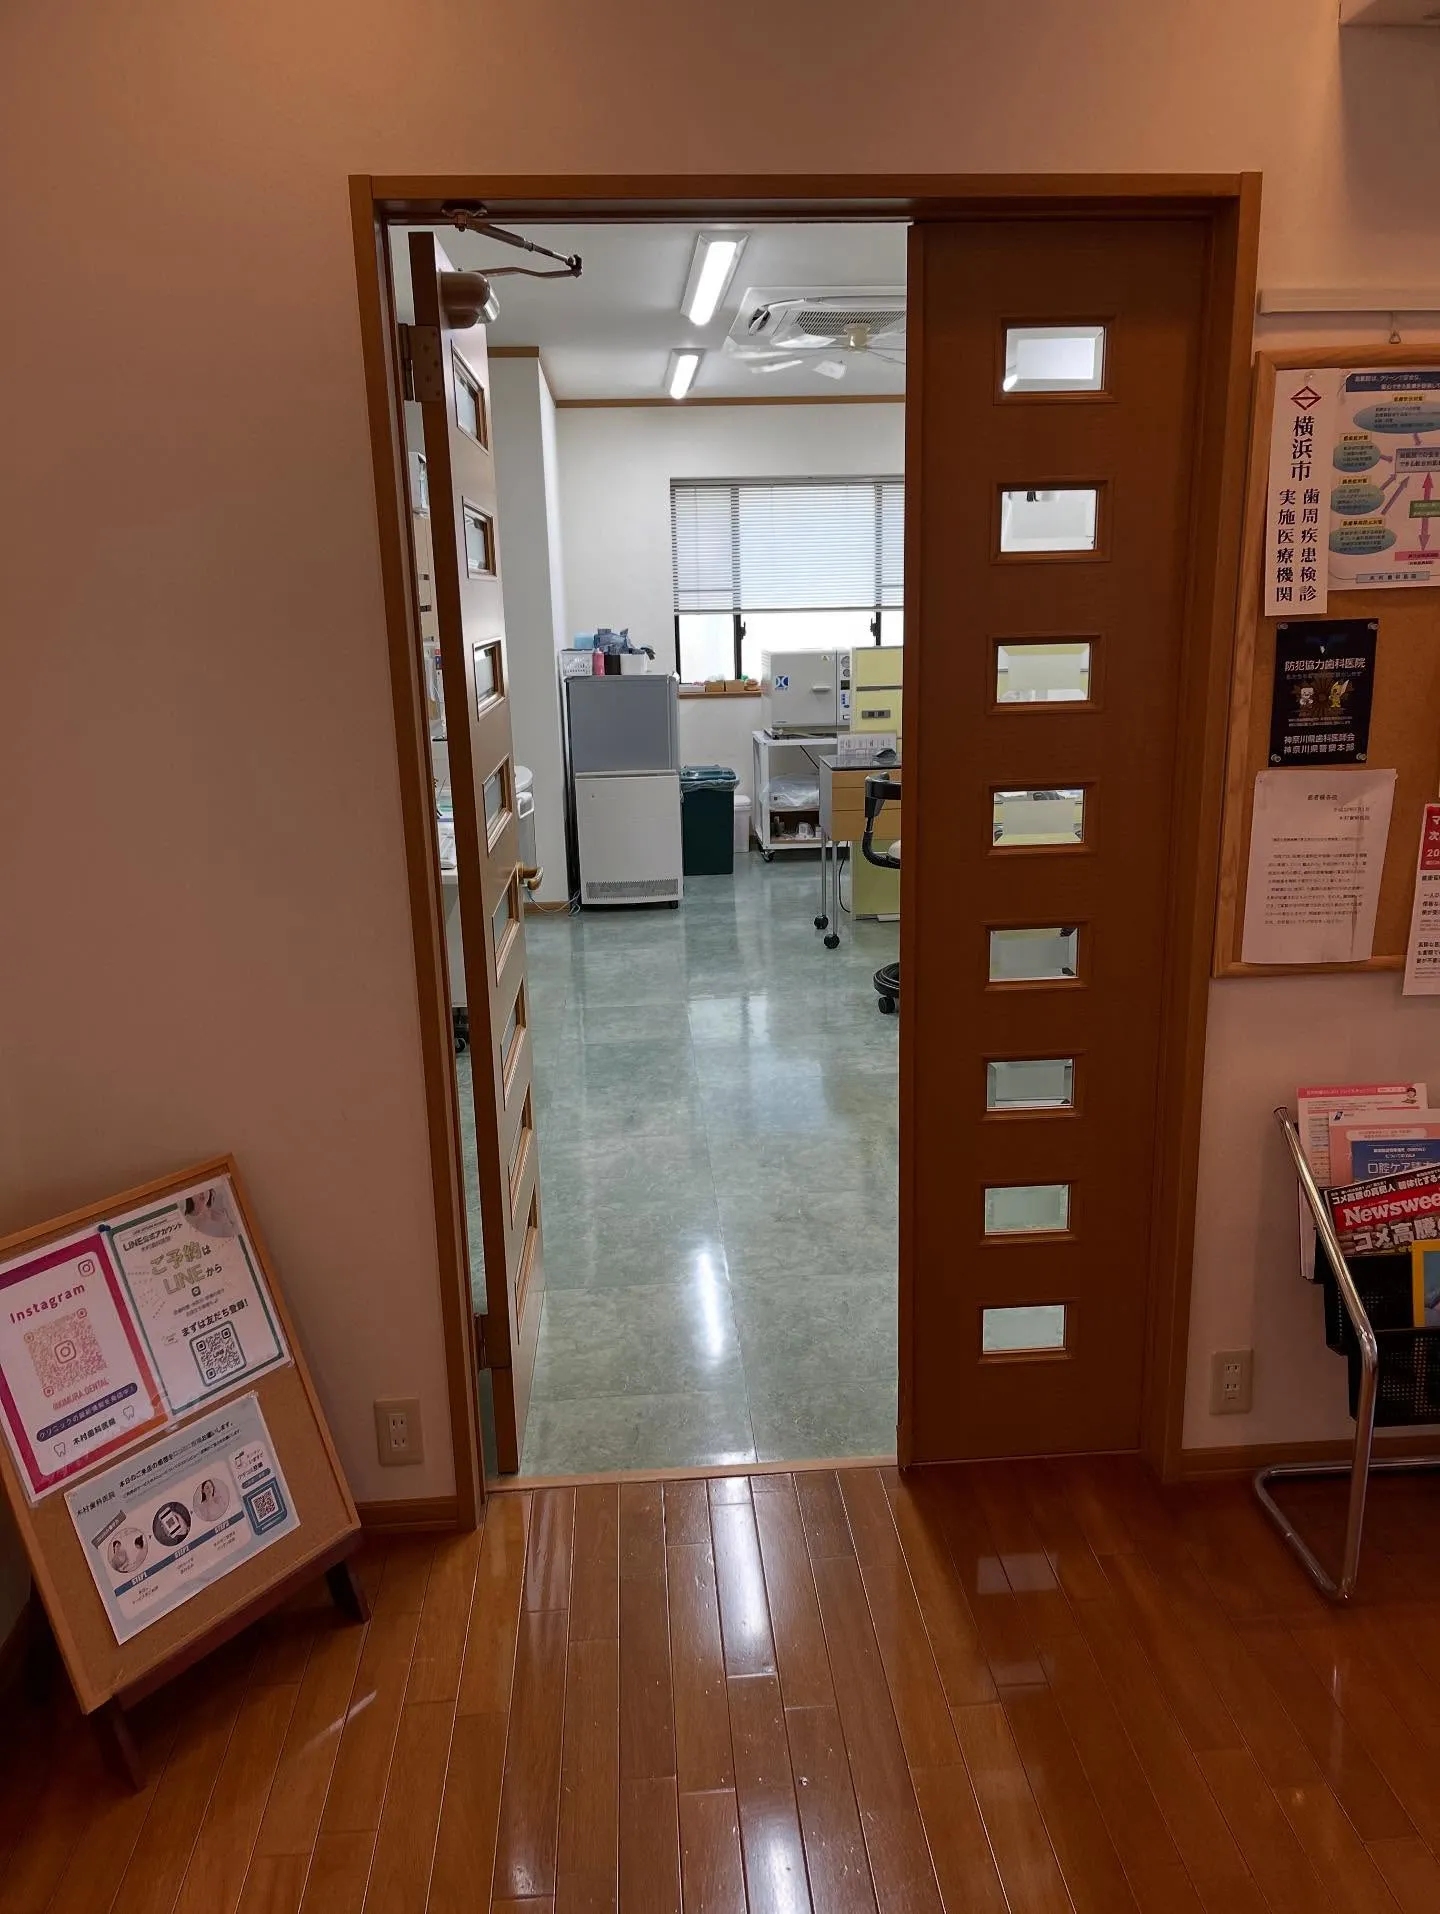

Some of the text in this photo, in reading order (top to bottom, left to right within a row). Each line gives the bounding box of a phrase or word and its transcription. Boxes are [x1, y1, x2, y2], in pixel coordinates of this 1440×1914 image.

[1291, 415, 1315, 482] 横浜市
[1276, 488, 1296, 603] 実施医療機関
[1299, 488, 1320, 602] 歯周疾患検診
[1284, 657, 1366, 672] 防犯協力歯科医院
[1283, 743, 1355, 755] 神奈川県警察本部
[1284, 732, 1356, 745] 神奈川県歯科医師会
[1353, 1216, 1440, 1252] コメ高騰
[150, 1241, 212, 1275] ご予約は
[163, 1263, 223, 1295] LINEから
[9, 1283, 86, 1324] Instagram
